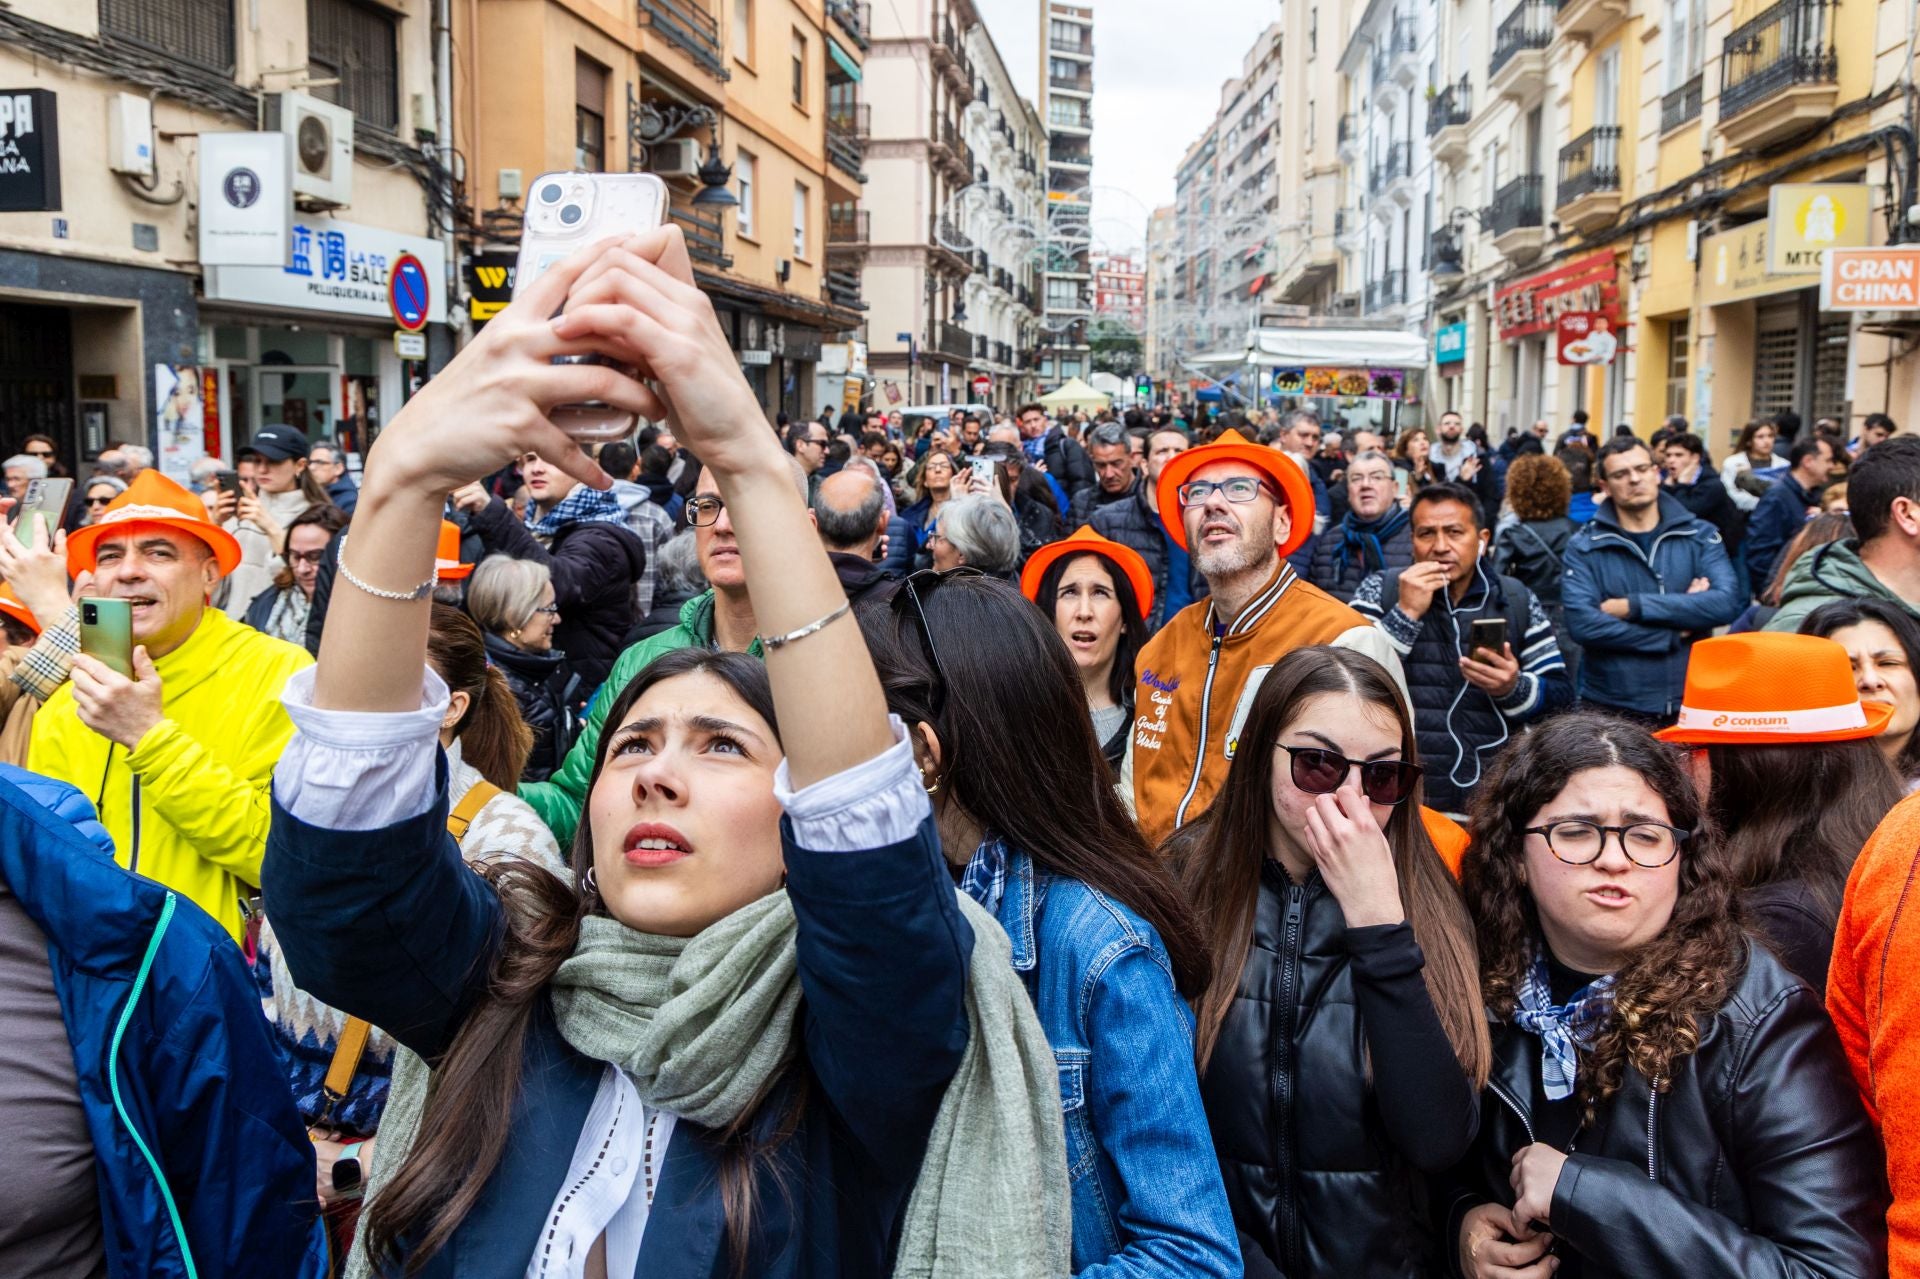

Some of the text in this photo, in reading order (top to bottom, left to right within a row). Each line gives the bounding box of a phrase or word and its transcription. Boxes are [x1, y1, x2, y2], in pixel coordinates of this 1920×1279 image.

[1839, 259, 1913, 280] GRAN
[1837, 283, 1913, 302] CHINA
[1730, 717, 1789, 726] consum
